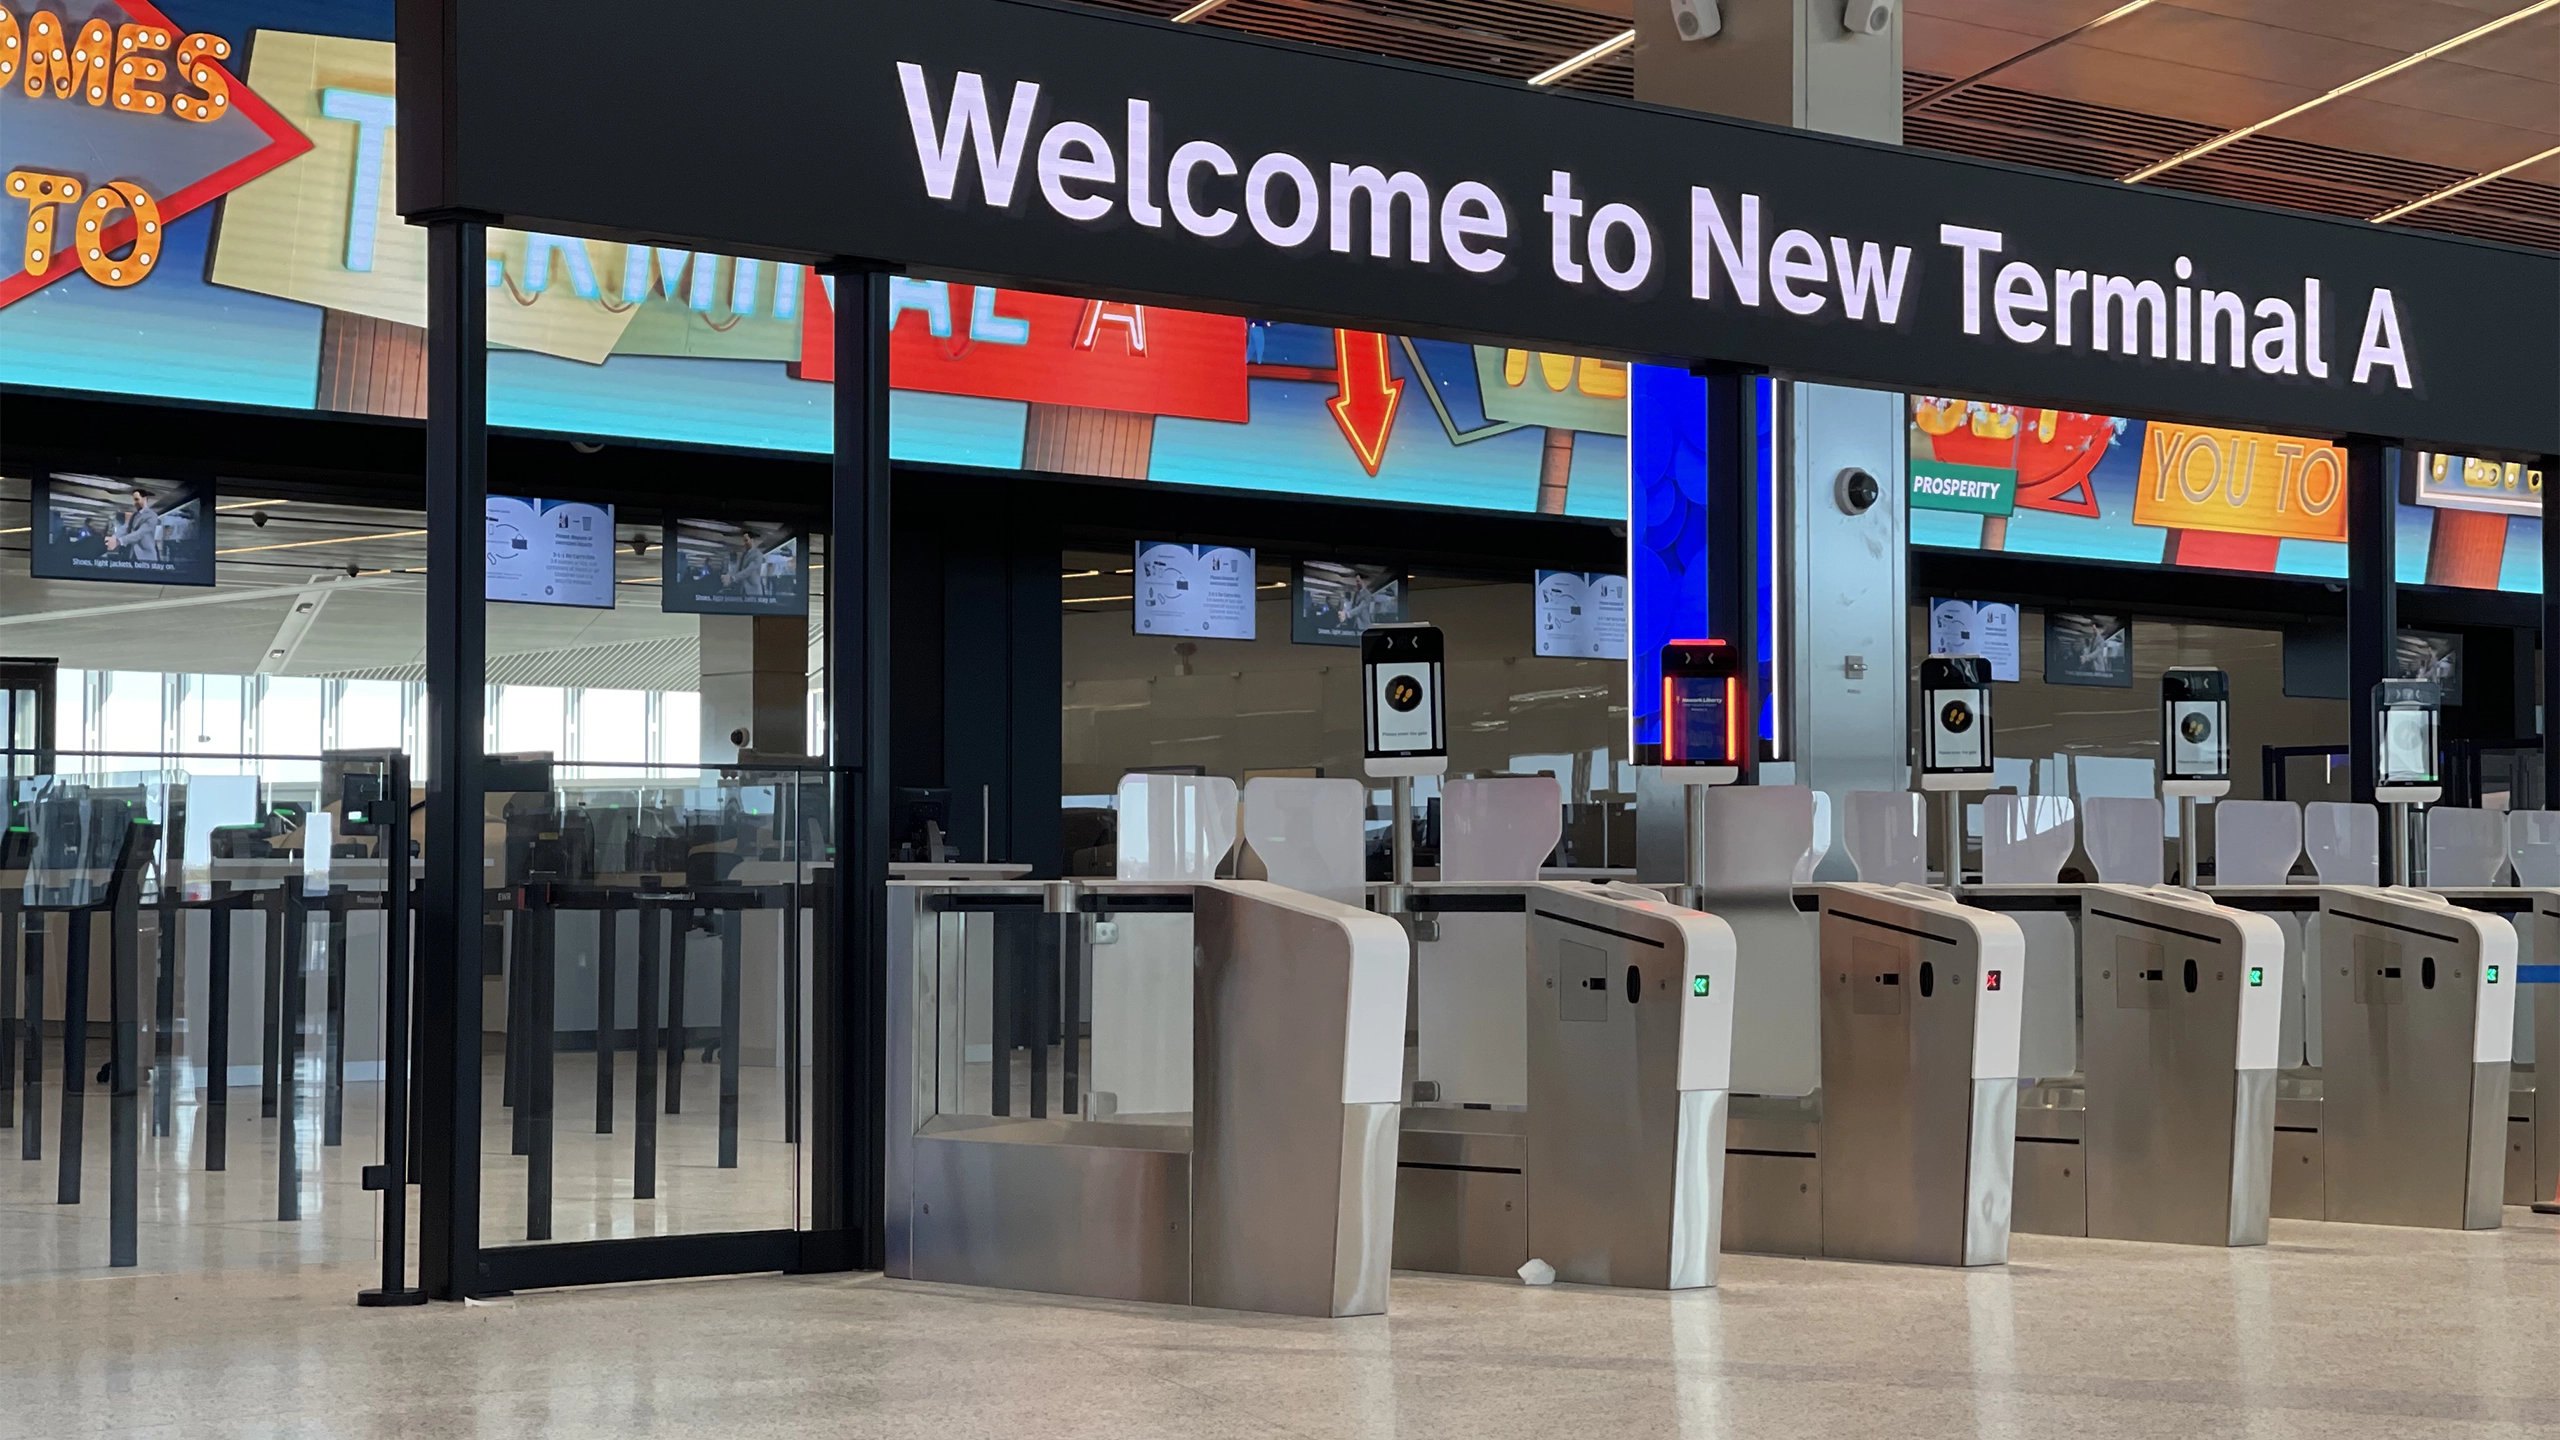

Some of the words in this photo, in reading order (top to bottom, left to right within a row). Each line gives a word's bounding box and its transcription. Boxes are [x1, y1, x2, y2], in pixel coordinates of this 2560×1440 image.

[5, 171, 162, 287] TO
[897, 62, 1508, 273] Welcome
[1544, 171, 1652, 292] to
[1691, 186, 1912, 324] New
[1941, 224, 2328, 379] Terminal
[2352, 288, 2413, 389] A
[1913, 474, 2001, 500] PROSPERITY
[2154, 429, 2257, 507] YOU
[2275, 443, 2342, 516] TO
[72, 557, 93, 567] Shoes,
[94, 559, 108, 568] light
[151, 562, 165, 570] stay
[497, 892, 511, 902] EWR
